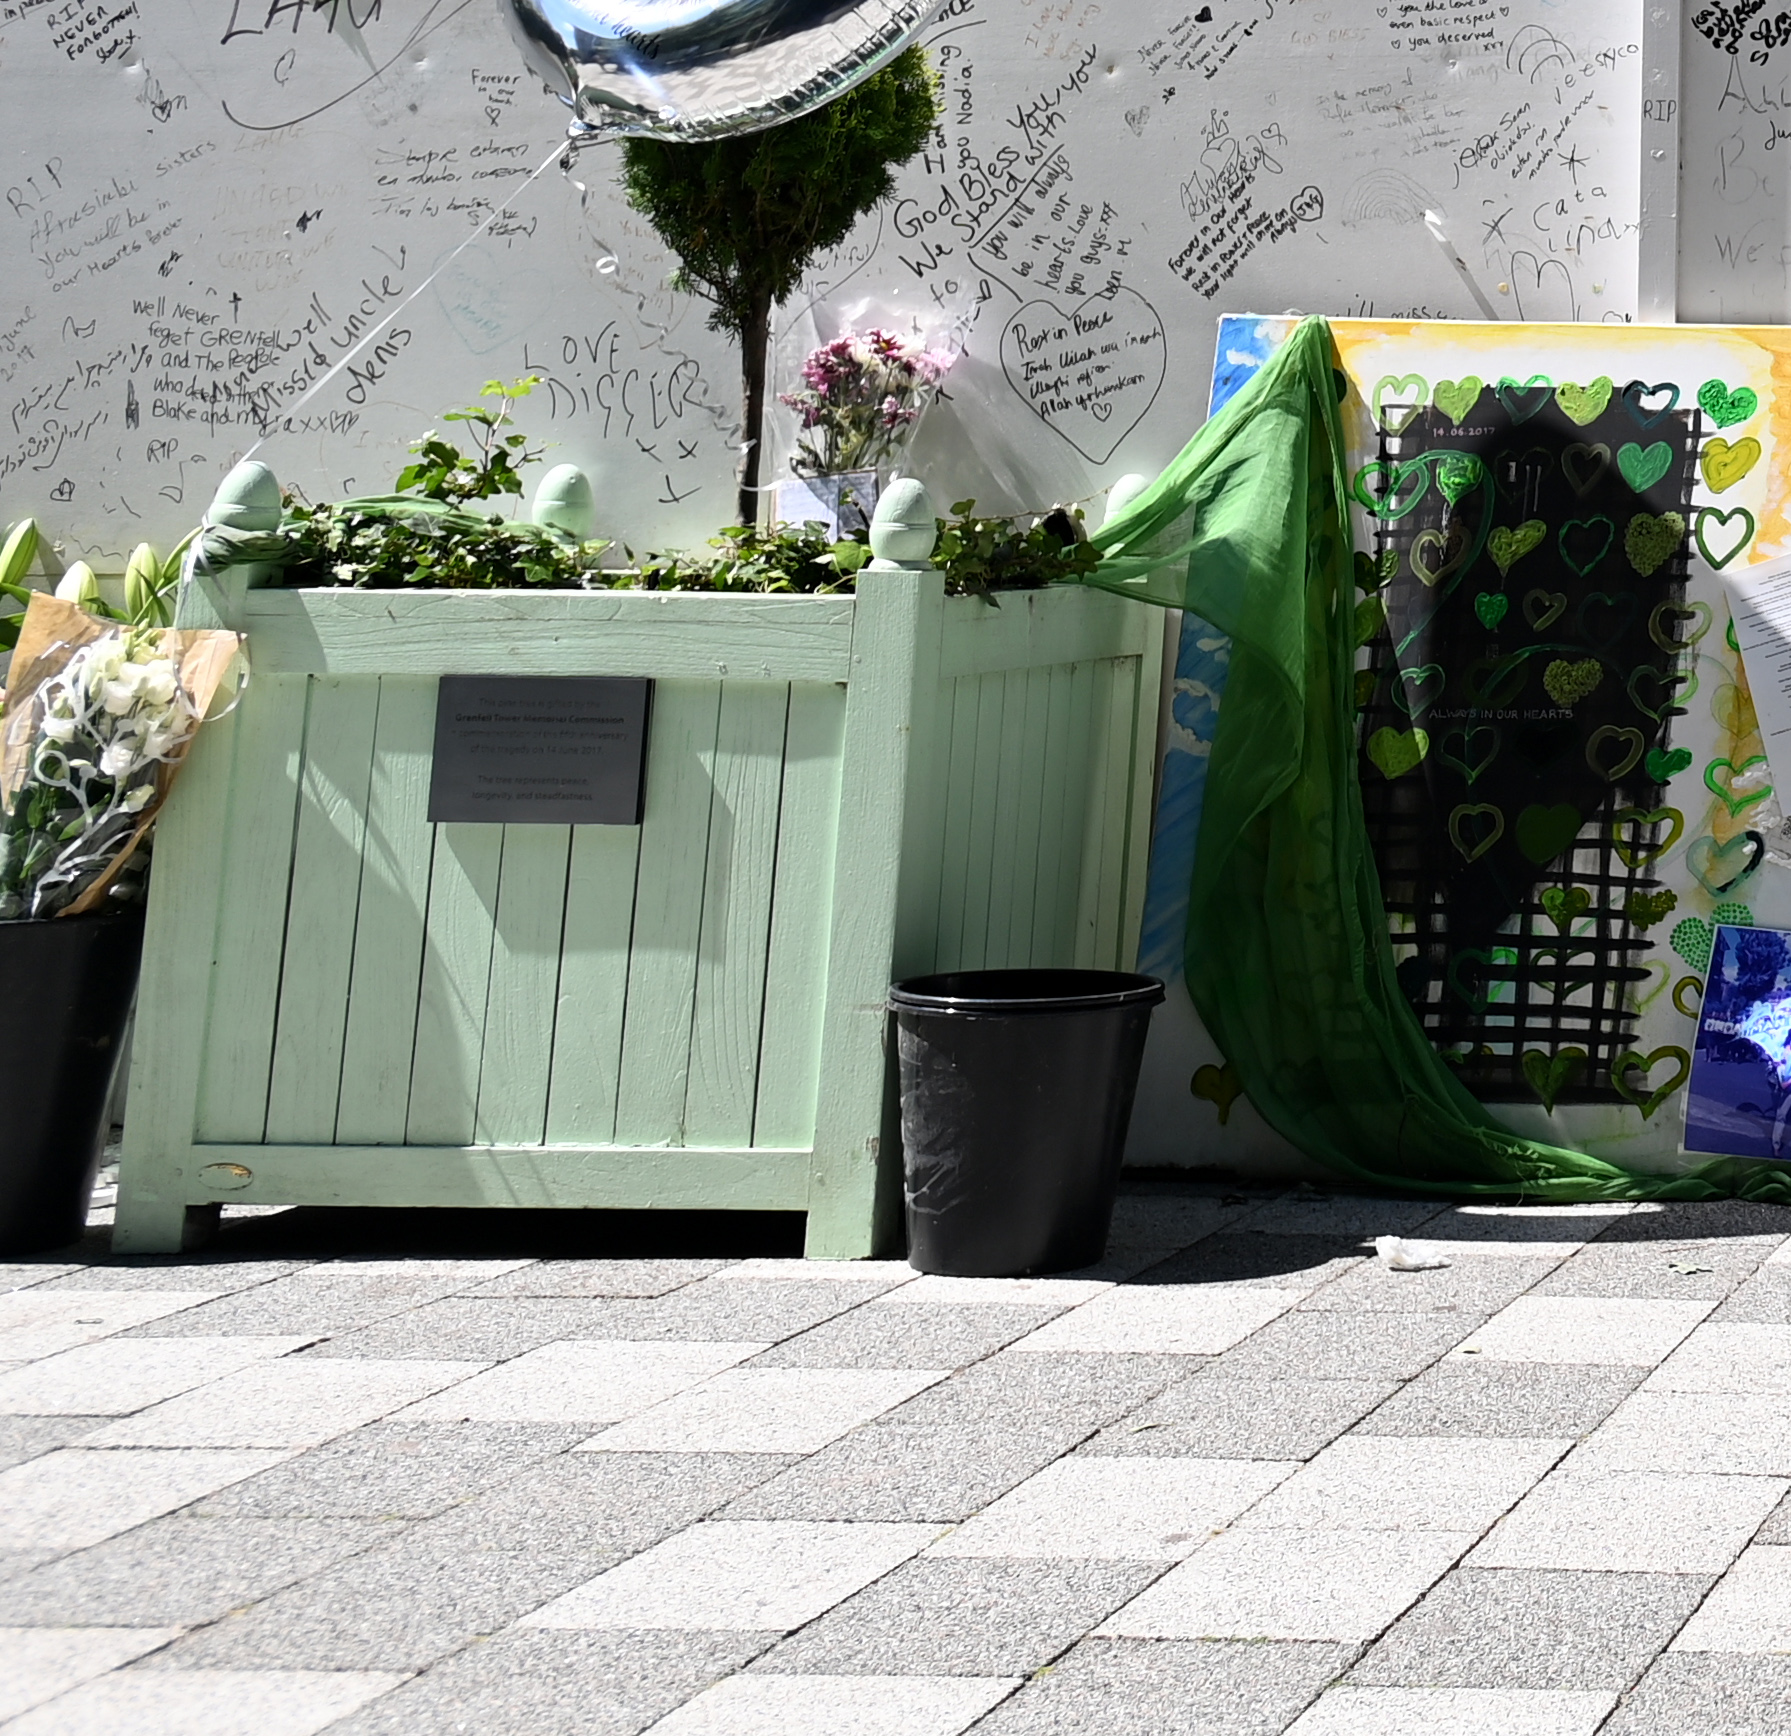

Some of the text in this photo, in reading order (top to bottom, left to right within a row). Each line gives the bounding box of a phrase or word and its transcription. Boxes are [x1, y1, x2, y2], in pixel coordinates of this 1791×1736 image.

[1432, 427, 1495, 437] 14.06.2017
[455, 714, 492, 722] Grenfell
[494, 714, 521, 722] Tower
[569, 716, 624, 724] Commission
